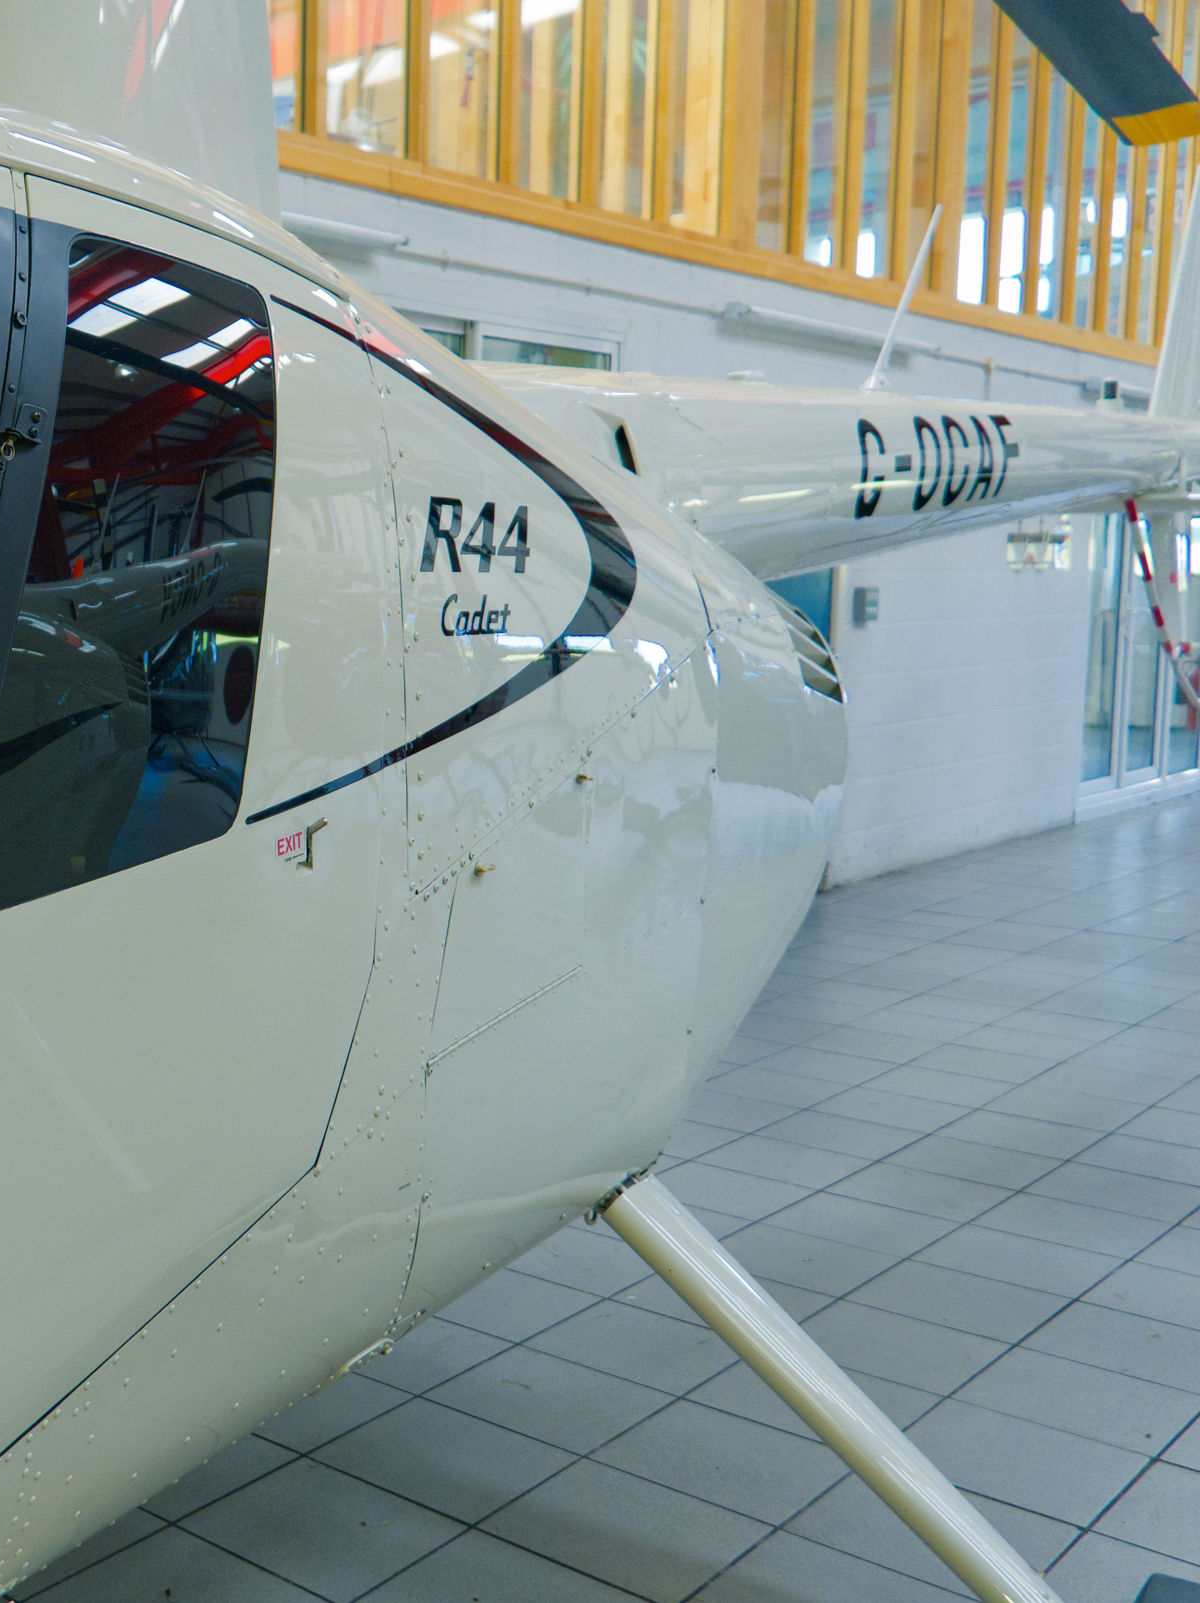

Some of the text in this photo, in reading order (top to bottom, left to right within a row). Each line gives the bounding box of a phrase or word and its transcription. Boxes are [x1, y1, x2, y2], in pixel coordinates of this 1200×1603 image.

[419, 496, 531, 573] R44
[441, 593, 511, 636] Cadet
[277, 831, 303, 857] EXIT
